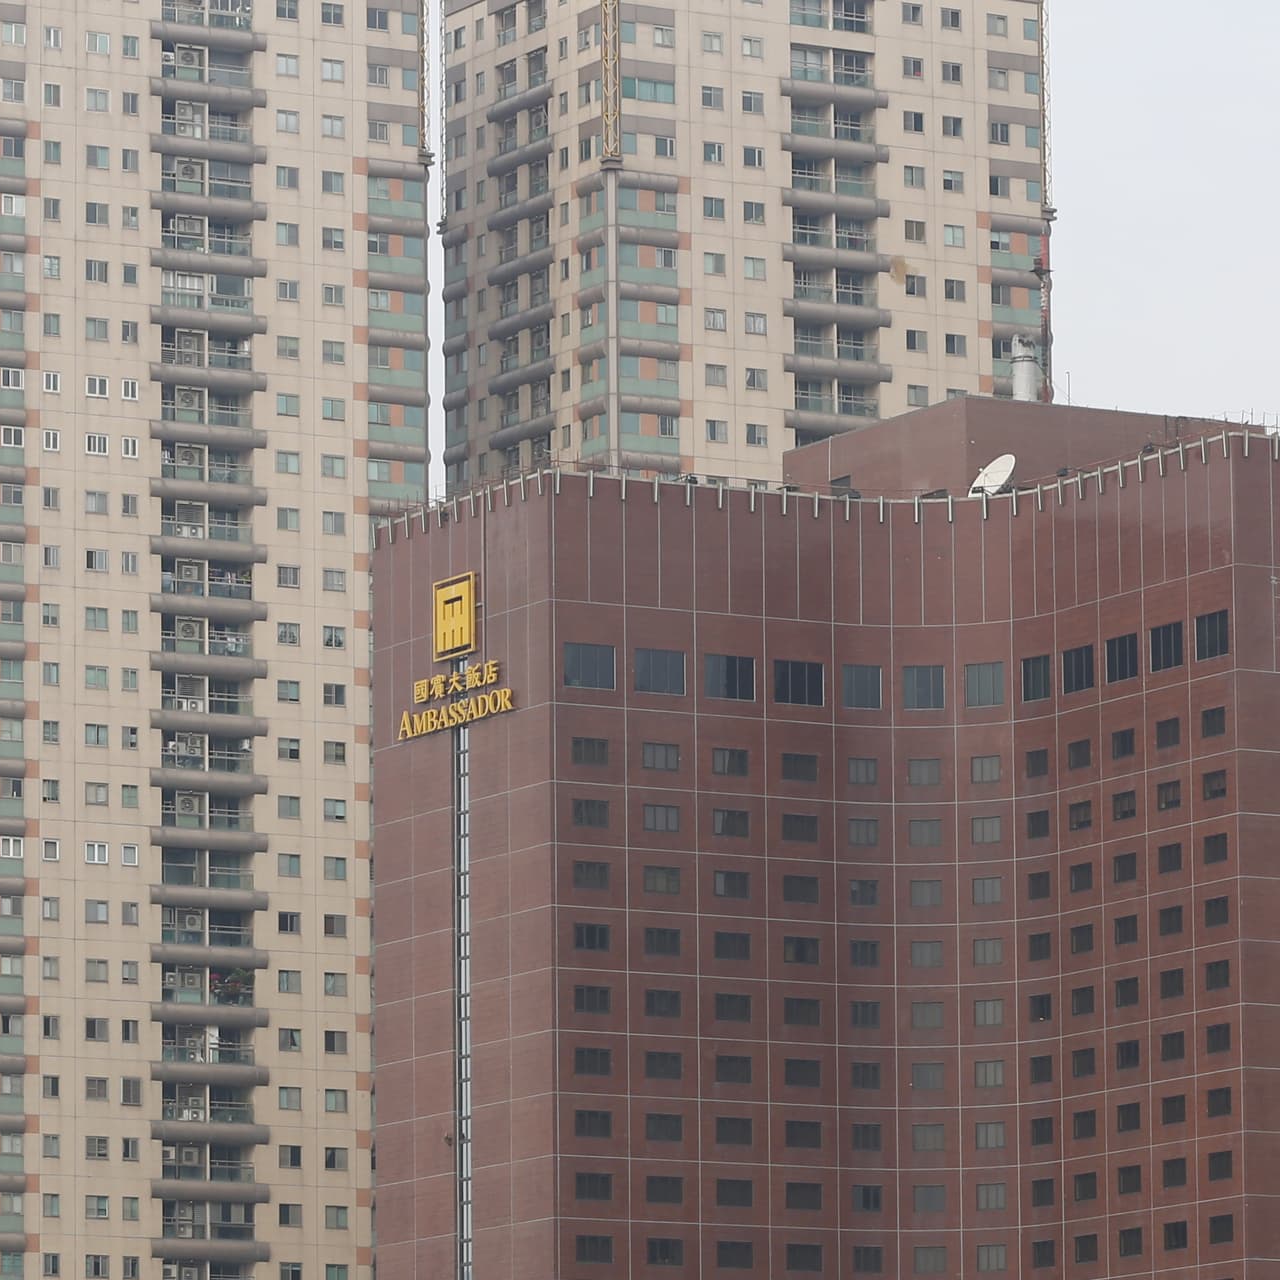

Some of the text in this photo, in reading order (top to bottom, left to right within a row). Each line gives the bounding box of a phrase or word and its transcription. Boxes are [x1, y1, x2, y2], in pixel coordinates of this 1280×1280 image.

[414, 660, 500, 704] 國賓大飯店
[397, 688, 514, 741] AMBASSADOR
